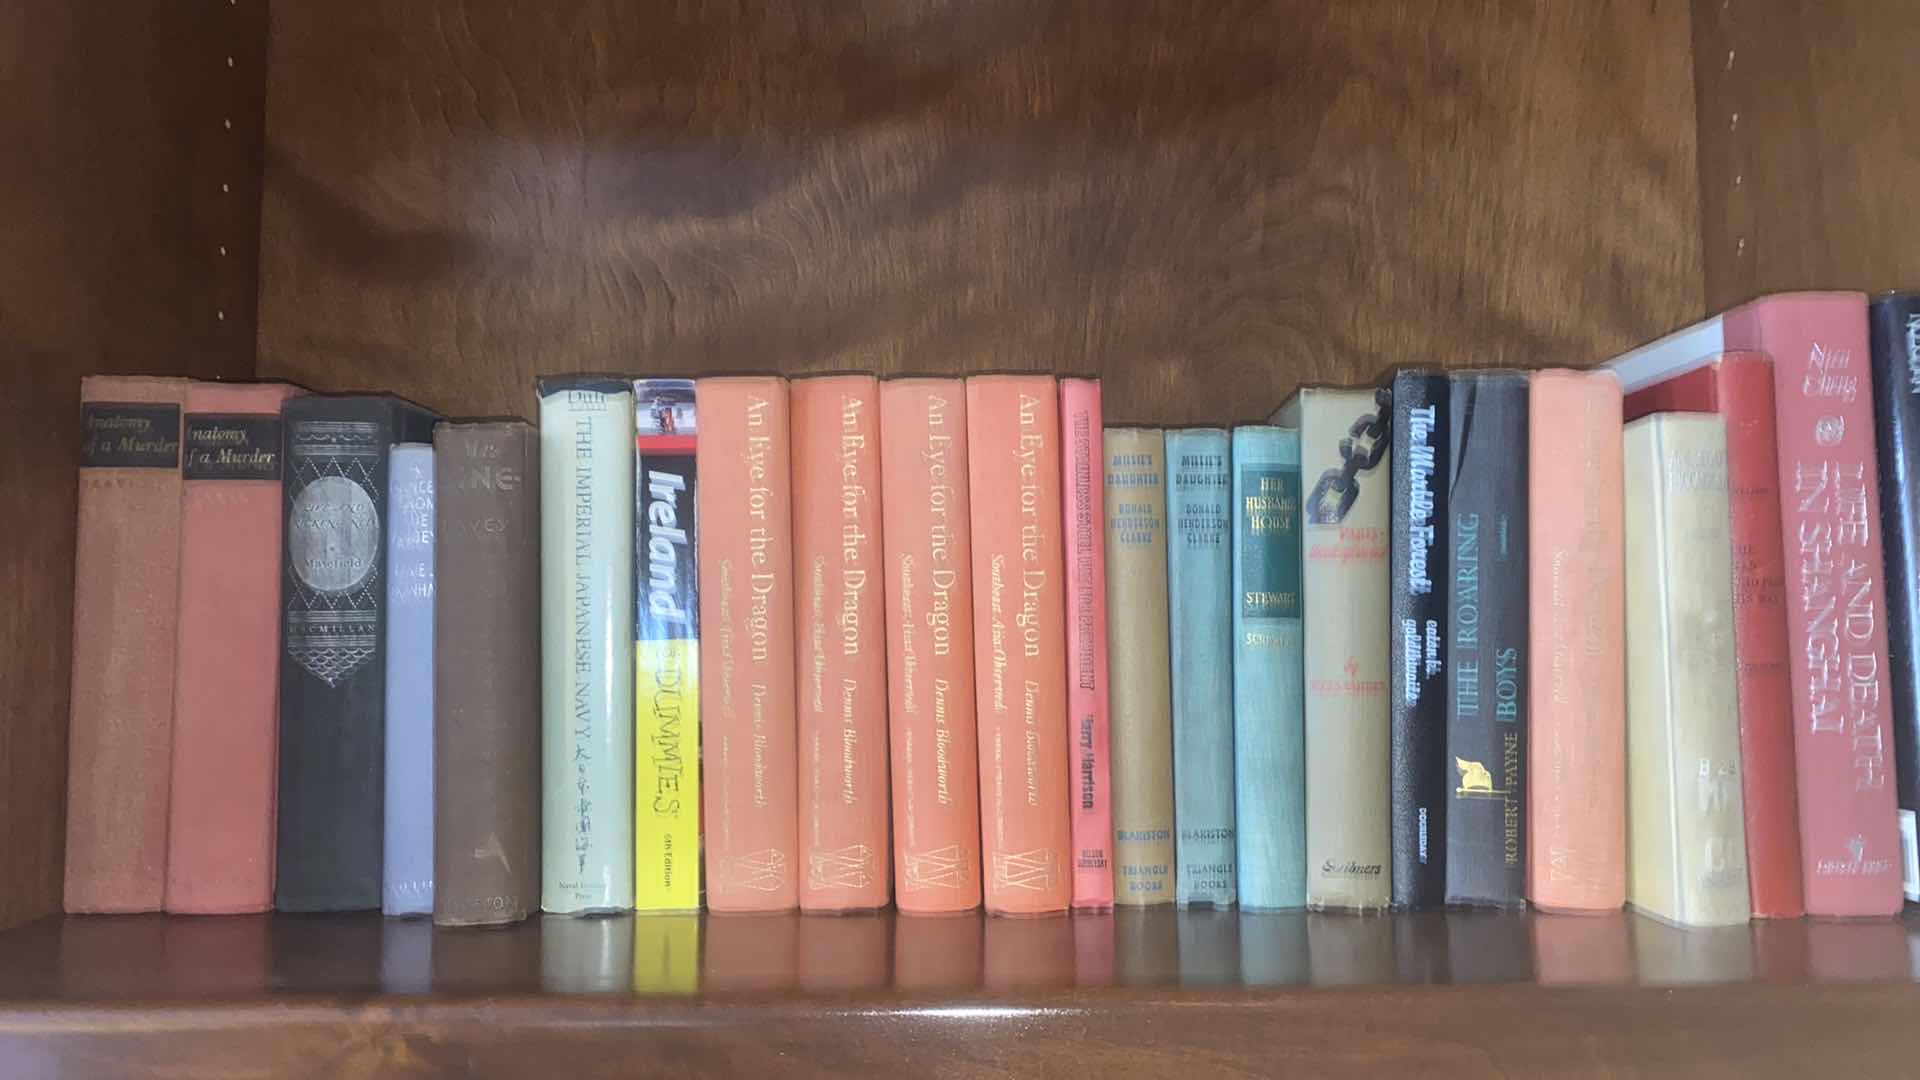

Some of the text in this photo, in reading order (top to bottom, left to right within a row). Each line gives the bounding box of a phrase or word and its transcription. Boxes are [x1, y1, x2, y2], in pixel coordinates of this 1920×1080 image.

[118, 436, 179, 454] Murder
[199, 452, 211, 464] a
[217, 447, 276, 466] Murder
[575, 416, 593, 459] THE
[1175, 473, 1228, 486] DAUGHTER
[1260, 477, 1284, 491] HER
[1409, 404, 1436, 595] The Marble Forest
[575, 467, 592, 566] IMPERIAL
[743, 396, 775, 662] An Eye for the Dragon
[836, 396, 868, 656] An Eye for the Dragon
[922, 395, 956, 657] An Eye for the Dragon
[1012, 394, 1048, 657] An Eye for the Dragon
[1110, 518, 1160, 529] HENDERSON
[1119, 503, 1153, 513] DONALD
[1177, 518, 1230, 529] HENDERSON
[1185, 503, 1222, 514] DONALD
[1250, 515, 1291, 530] HOUSE
[647, 470, 687, 625] Ireland
[1120, 533, 1152, 543] CLARKE
[1186, 532, 1221, 544] CLARKE
[989, 553, 1007, 613] Southeast
[1245, 591, 1297, 605] STEWART
[1794, 460, 1844, 737] IN SHANGHAI
[575, 573, 592, 674] JAPANESE
[1456, 513, 1479, 721] THE ROARING
[1835, 461, 1886, 793] LIFE AND DEATH
[574, 681, 592, 739] NAVY
[1495, 648, 1518, 722] BOYS
[652, 667, 684, 813] DUMMIES
[936, 728, 952, 807] Bloodworth
[1081, 753, 1096, 809] Harrison
[1503, 733, 1518, 865] ROBERT PAYNE
[1418, 807, 1428, 865] DOUBLEDAY
[663, 852, 673, 890] Edition
[1121, 864, 1169, 875] TRIANGLE
[1129, 881, 1163, 891] BOOKS
[1186, 863, 1233, 875] TRIANGLE
[1193, 880, 1227, 889] BOOKS
